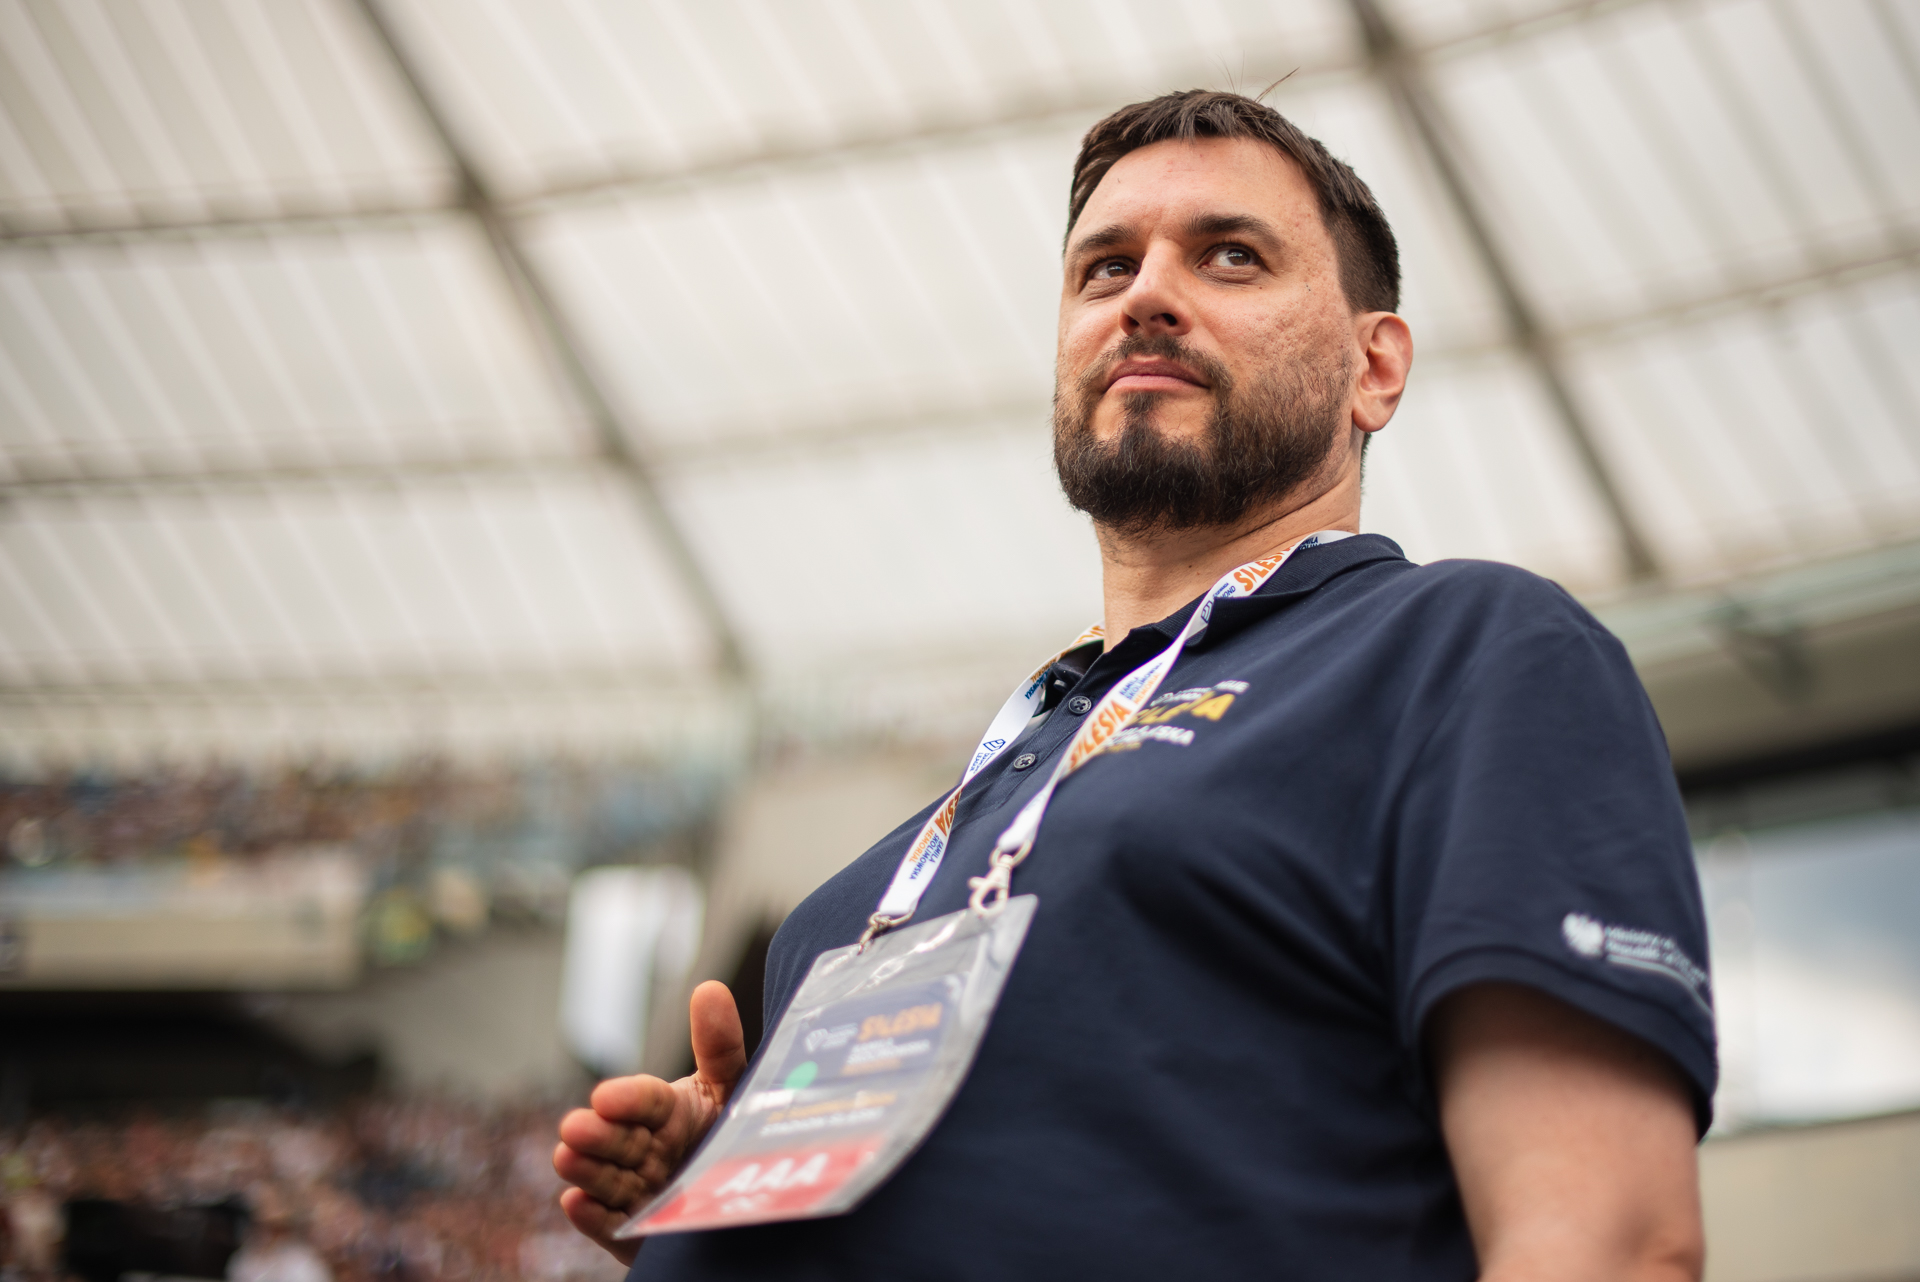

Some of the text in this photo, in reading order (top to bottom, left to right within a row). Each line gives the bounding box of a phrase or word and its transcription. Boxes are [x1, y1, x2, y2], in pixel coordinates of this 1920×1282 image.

[908, 826, 935, 863] MEMORIAL
[908, 833, 940, 880] SKOLIMOWSKA
[929, 841, 944, 864] KAMILA
